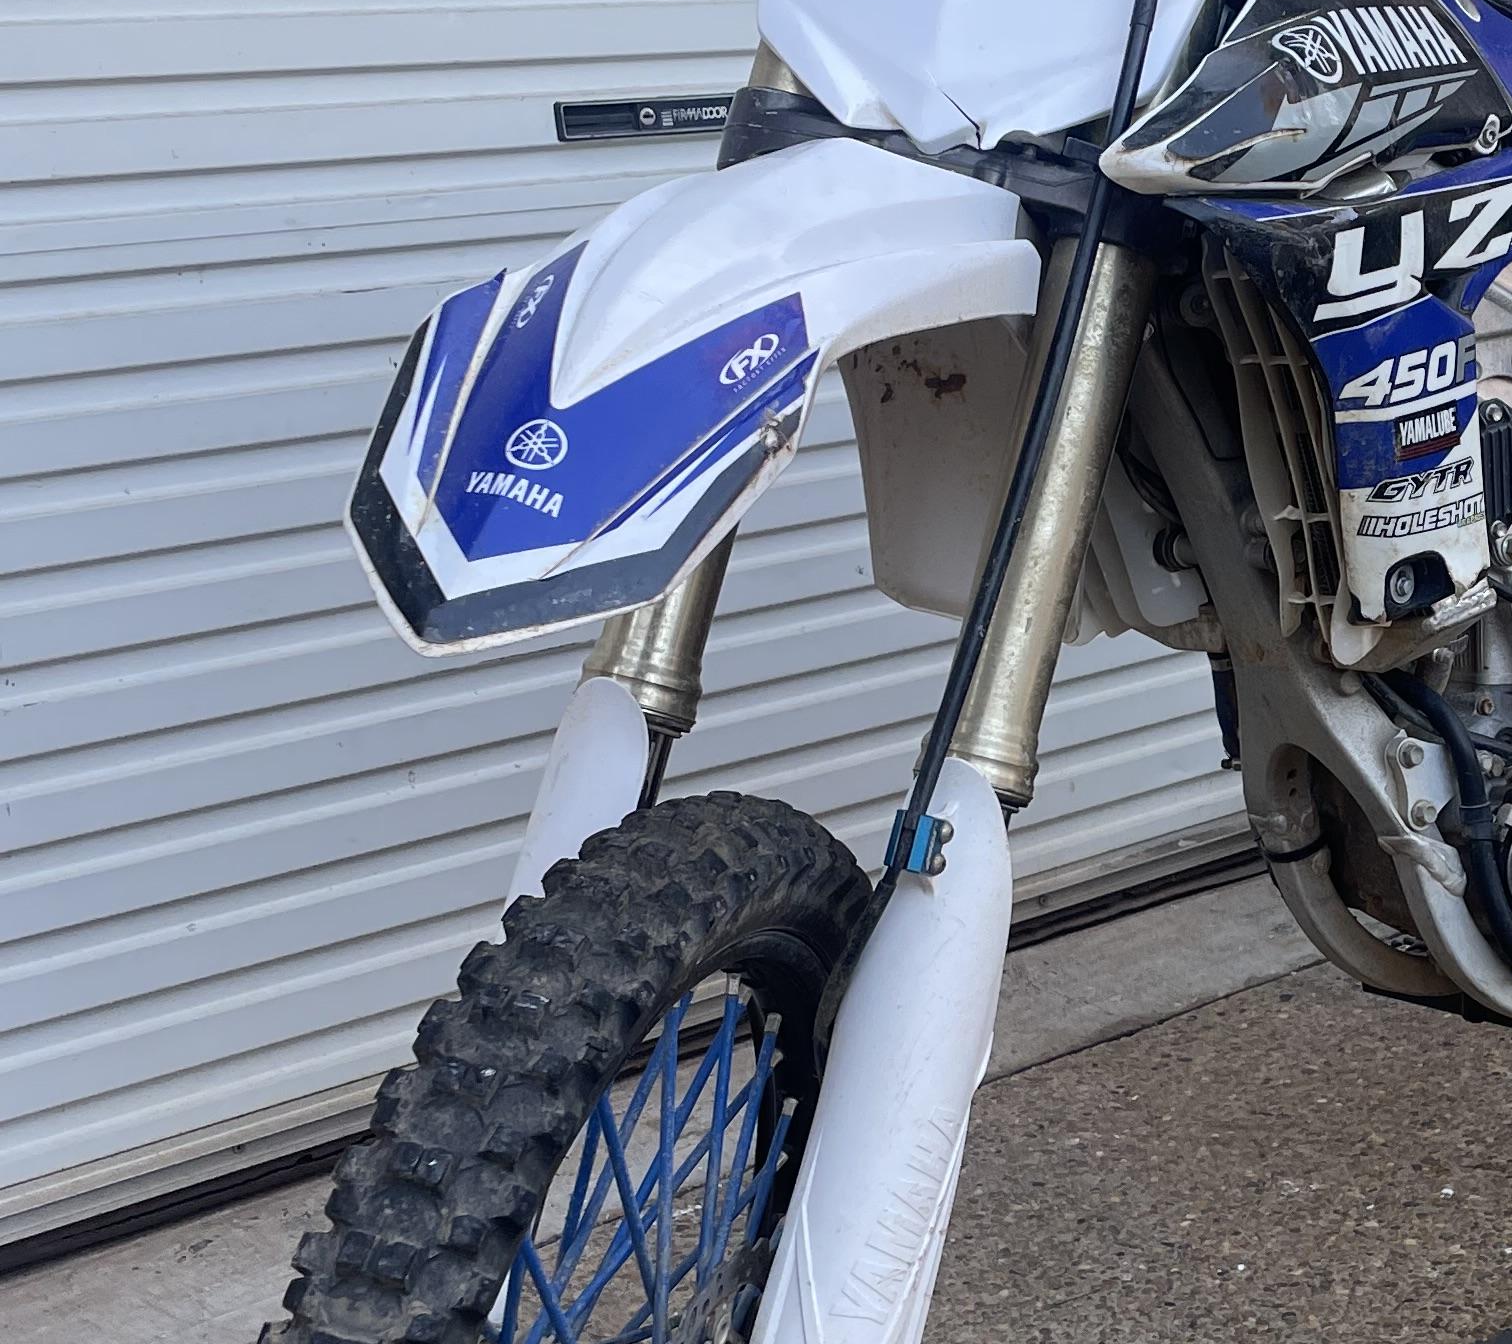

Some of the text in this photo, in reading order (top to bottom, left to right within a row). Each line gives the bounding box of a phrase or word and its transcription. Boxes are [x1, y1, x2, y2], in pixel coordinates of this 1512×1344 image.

[1311, 6, 1467, 75] YAMAHA
[1400, 407, 1457, 447] YAMALUBE
[465, 471, 565, 518] YAMAHA
[1366, 456, 1475, 503] GYTR
[1372, 492, 1485, 538] HOLESHOT
[829, 1107, 956, 1326] YAMAHA
